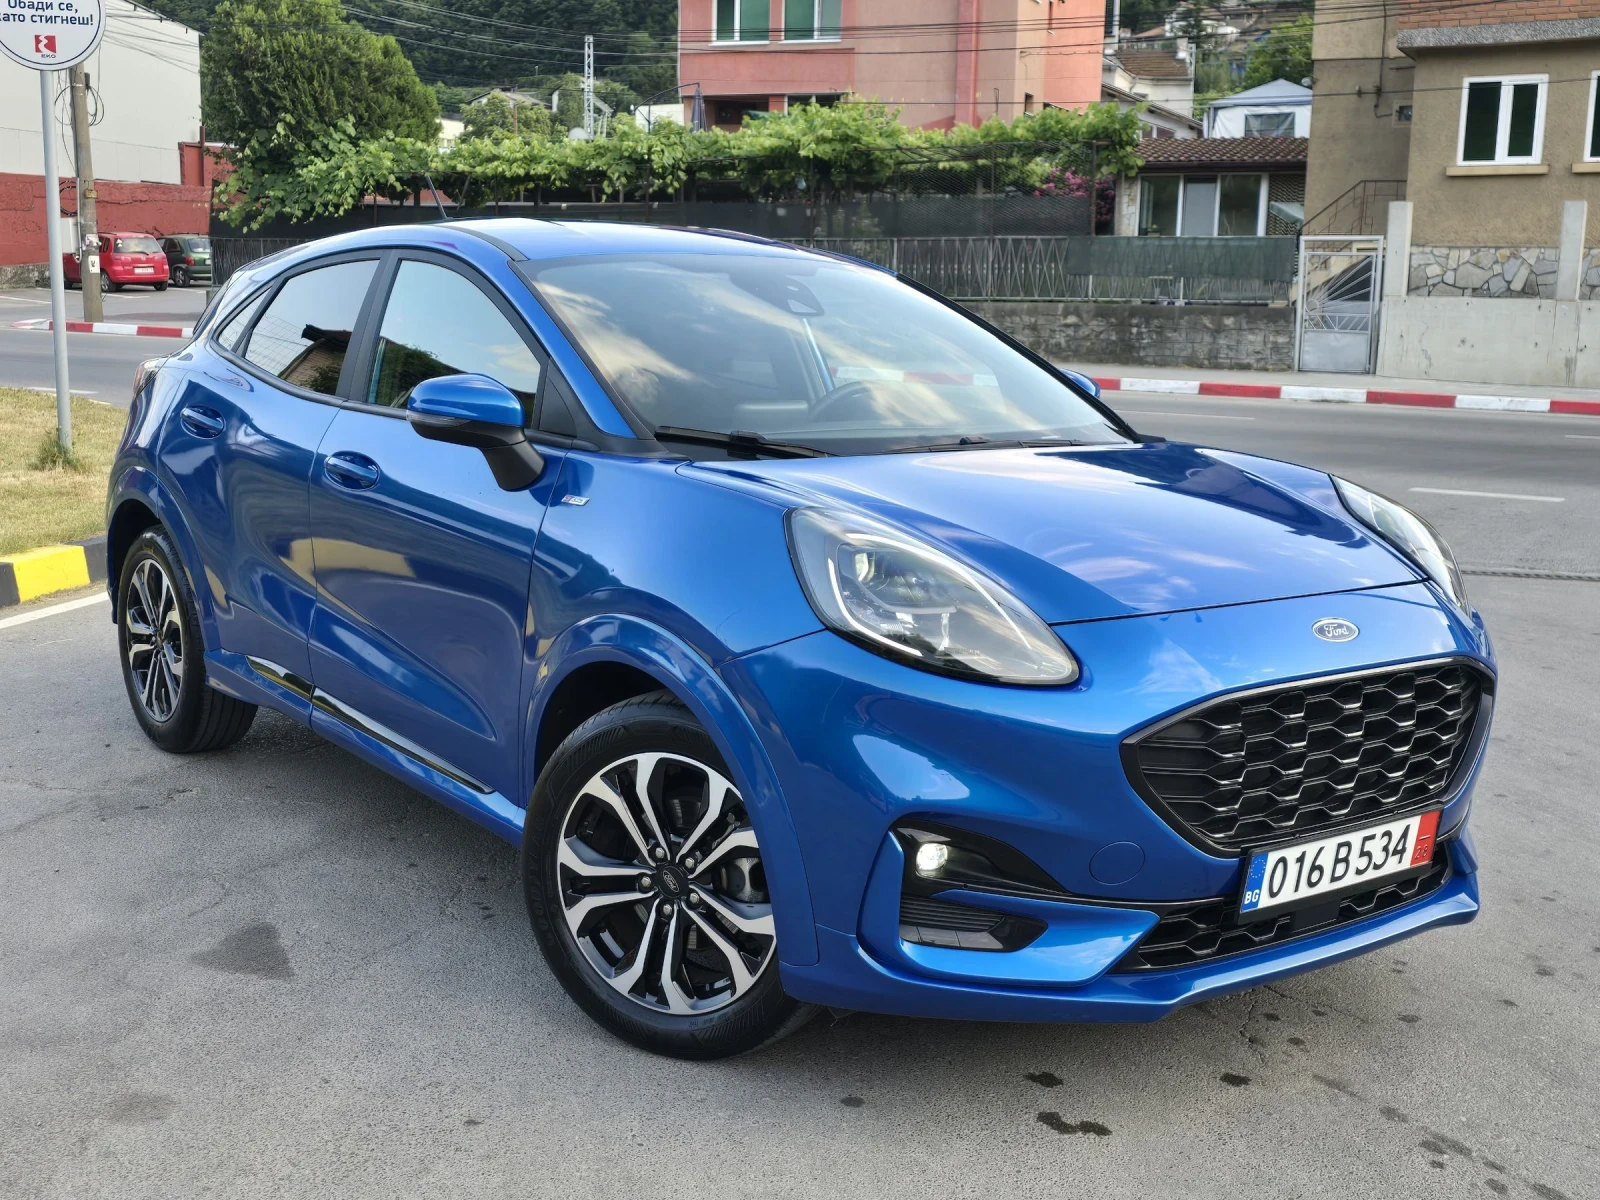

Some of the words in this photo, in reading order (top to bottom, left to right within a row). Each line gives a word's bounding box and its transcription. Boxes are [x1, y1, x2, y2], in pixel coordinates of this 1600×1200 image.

[7, 0, 54, 12] Обади
[58, 2, 78, 14] се,
[0, 13, 26, 22] ато
[30, 14, 94, 26] стигнеш!
[1268, 824, 1411, 899] 016B534
[1244, 889, 1260, 905] BG
